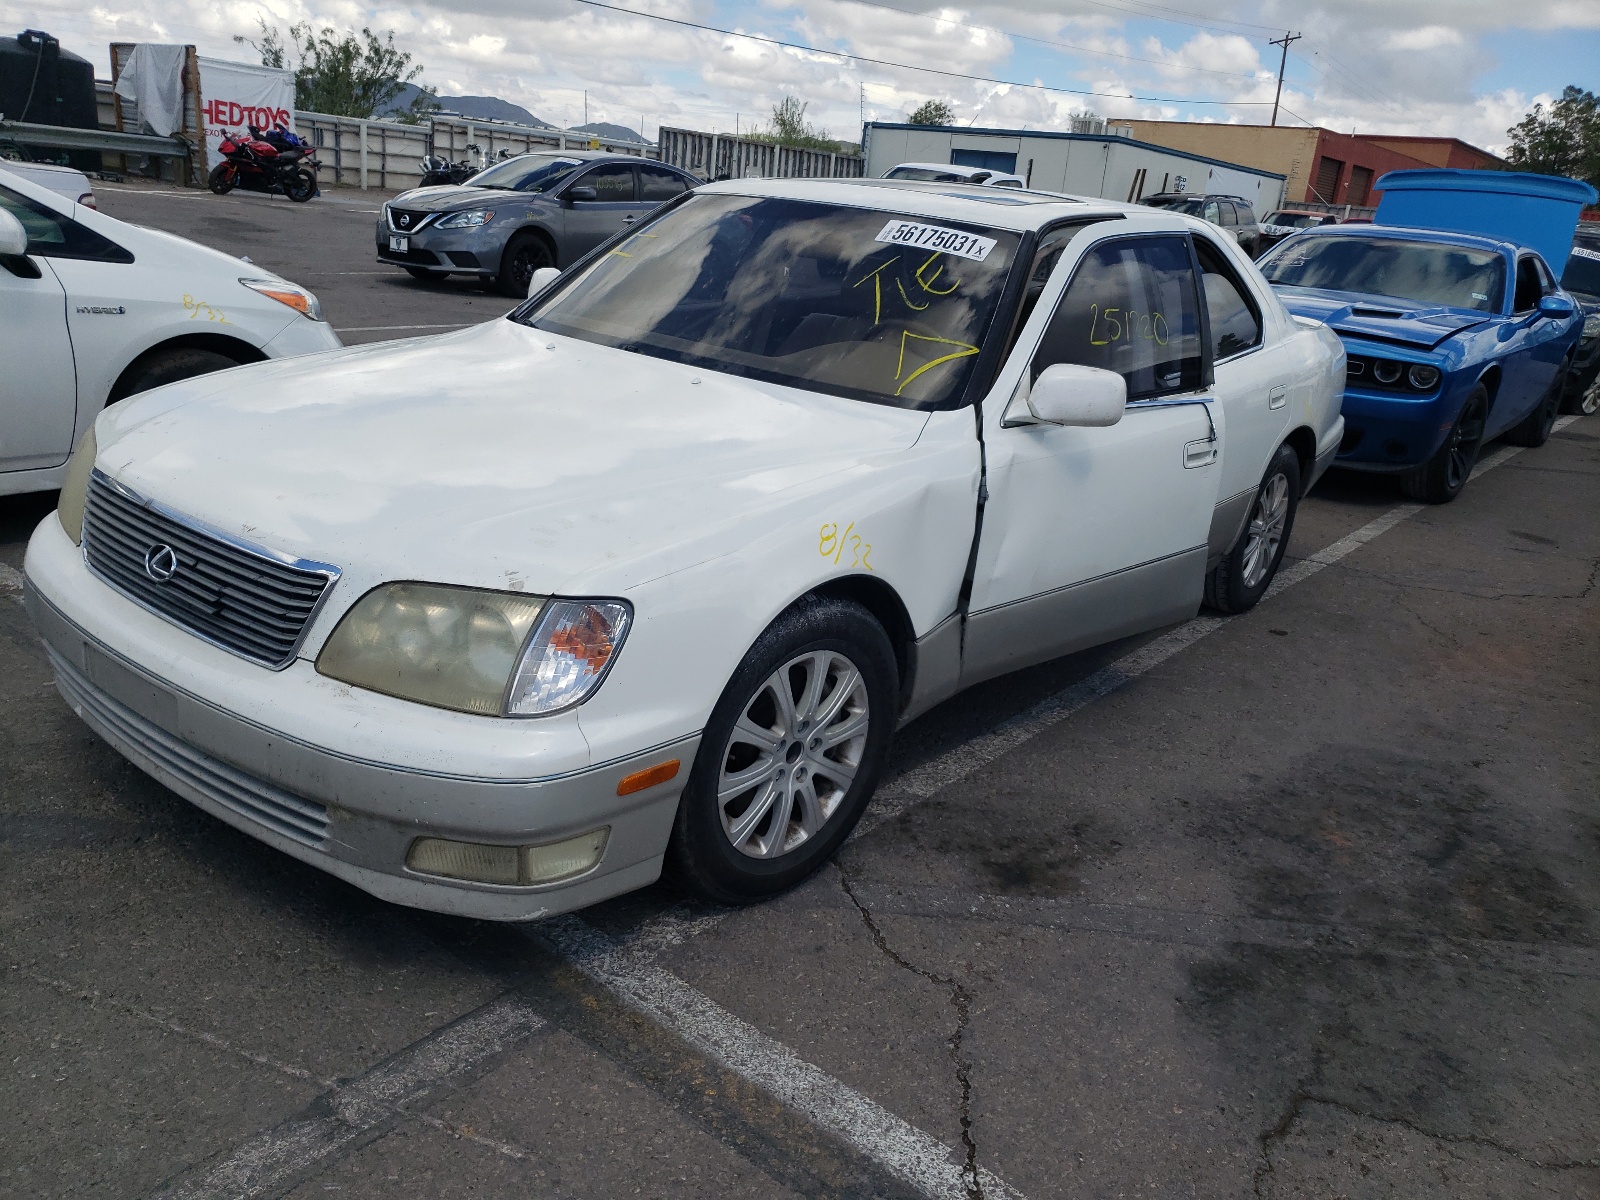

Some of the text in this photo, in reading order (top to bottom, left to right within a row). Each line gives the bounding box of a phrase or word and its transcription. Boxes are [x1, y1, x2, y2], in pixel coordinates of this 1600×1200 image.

[891, 224, 979, 255] 56175031
[76, 306, 126, 315] HYBRID
[819, 521, 873, 570] 8/32
